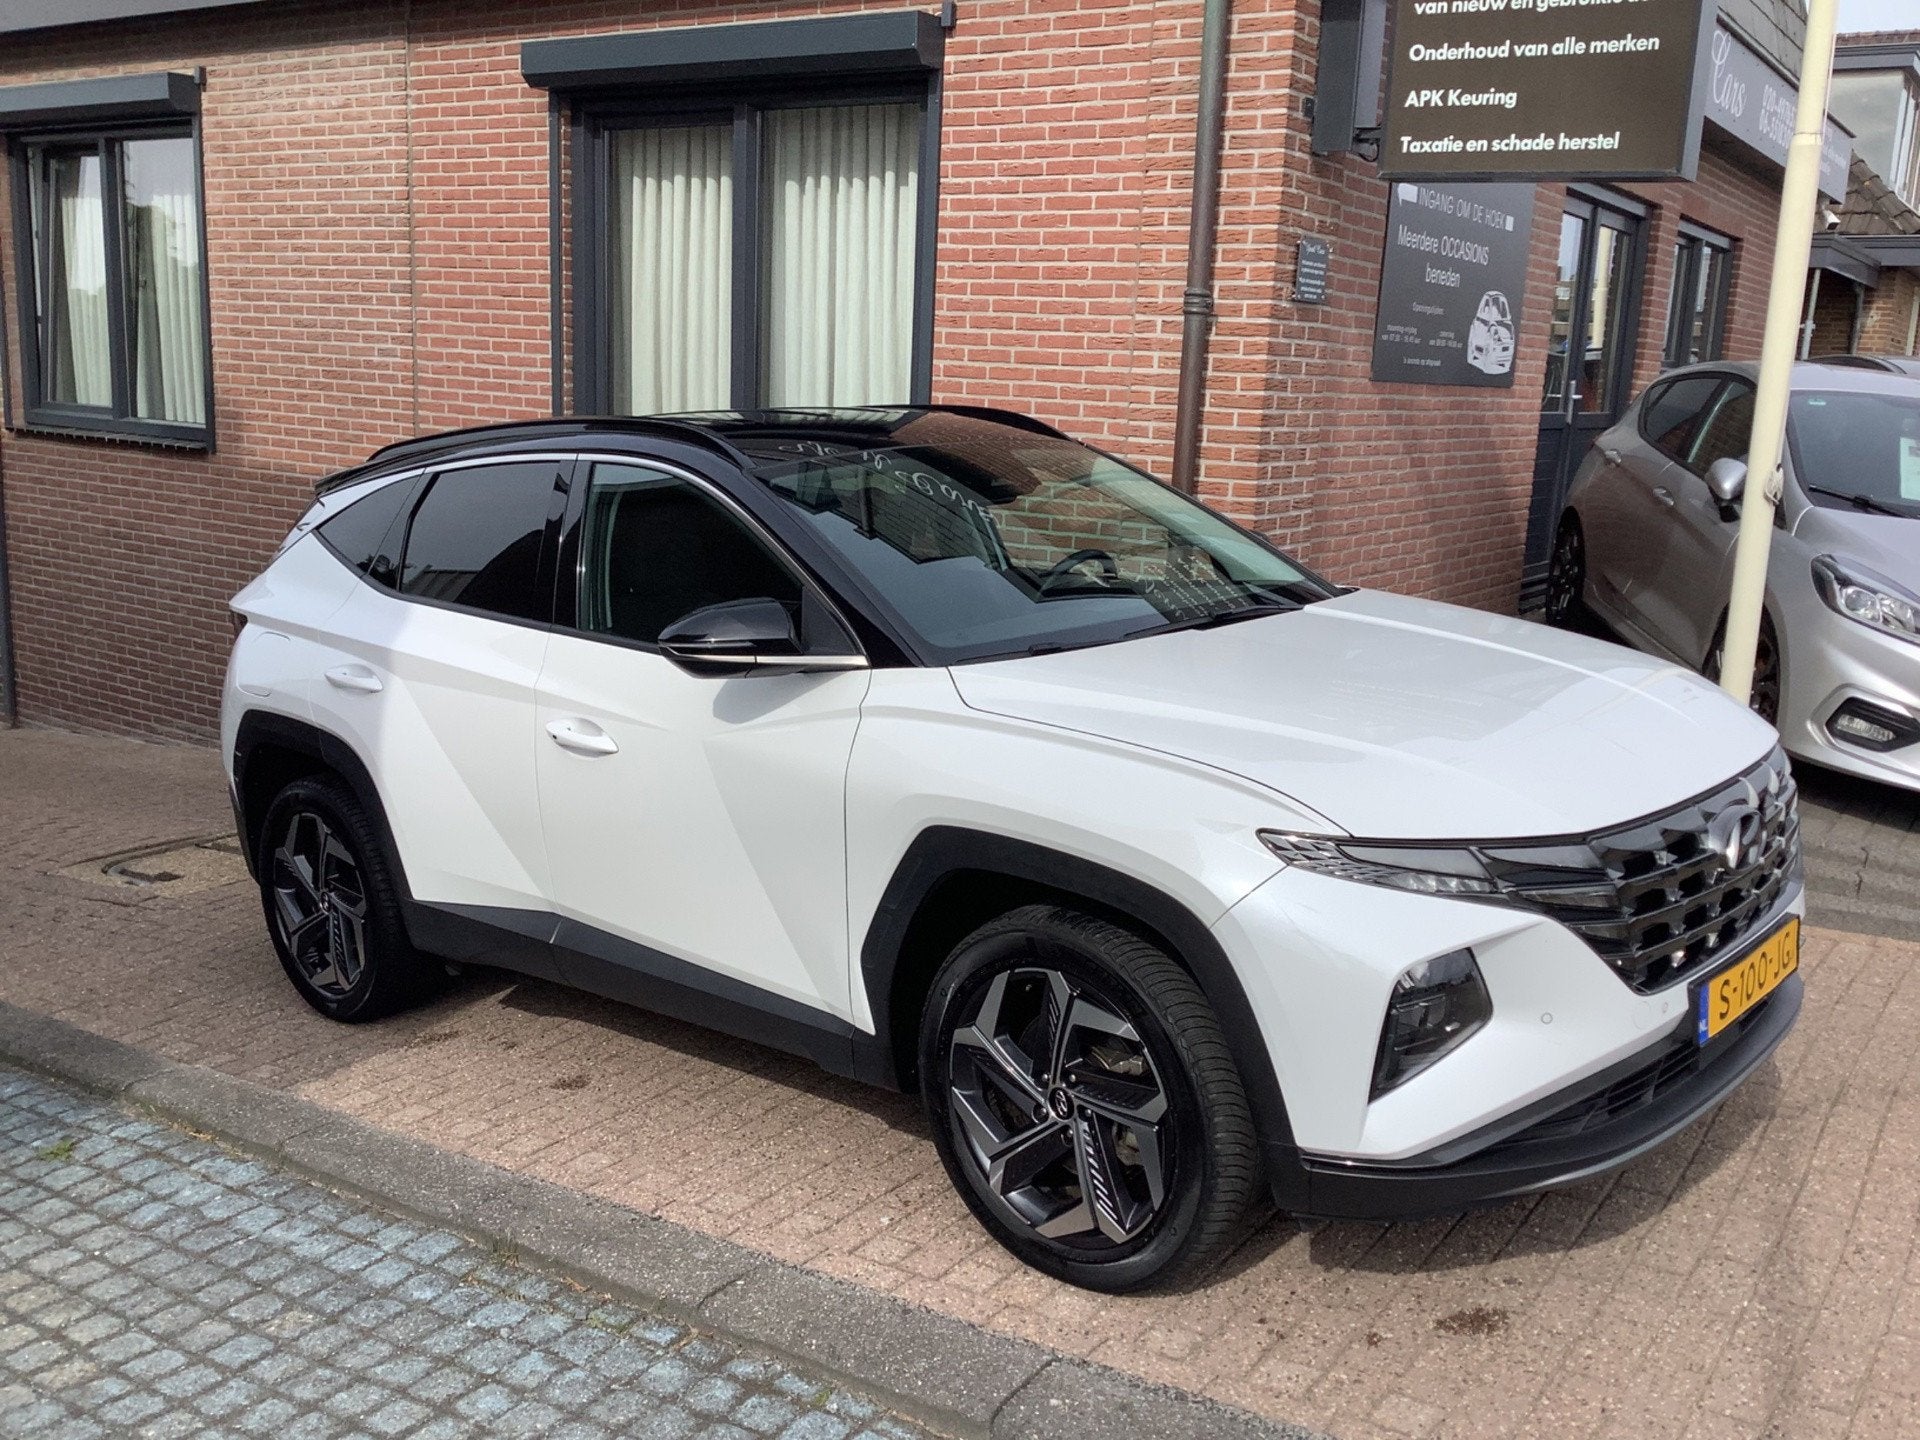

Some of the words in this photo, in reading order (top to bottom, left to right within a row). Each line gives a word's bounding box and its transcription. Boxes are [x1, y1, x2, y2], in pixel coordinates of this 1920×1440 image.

[1413, 1, 1449, 15] van
[1451, 0, 1507, 13] nieuw
[1409, 39, 1510, 62] Onderhoud
[1513, 43, 1548, 58] van
[1551, 37, 1585, 55] alle
[1589, 33, 1660, 54] merken
[1711, 29, 1747, 118] Cars
[1404, 89, 1444, 108] APK
[1447, 87, 1518, 109] Keuring
[1400, 135, 1463, 154] Taxatie
[1466, 137, 1489, 152] en
[1491, 132, 1556, 152] schade
[1558, 131, 1621, 151] herstel
[1418, 187, 1455, 213] INGANG
[1456, 198, 1471, 219] OM
[1472, 203, 1485, 224] DE
[1485, 209, 1505, 231] HOEK
[1397, 224, 1439, 252] Meerdere
[1440, 235, 1490, 266] OCCASIONS
[1425, 262, 1461, 288] beneden
[1719, 932, 1790, 1020] S-100-JG
